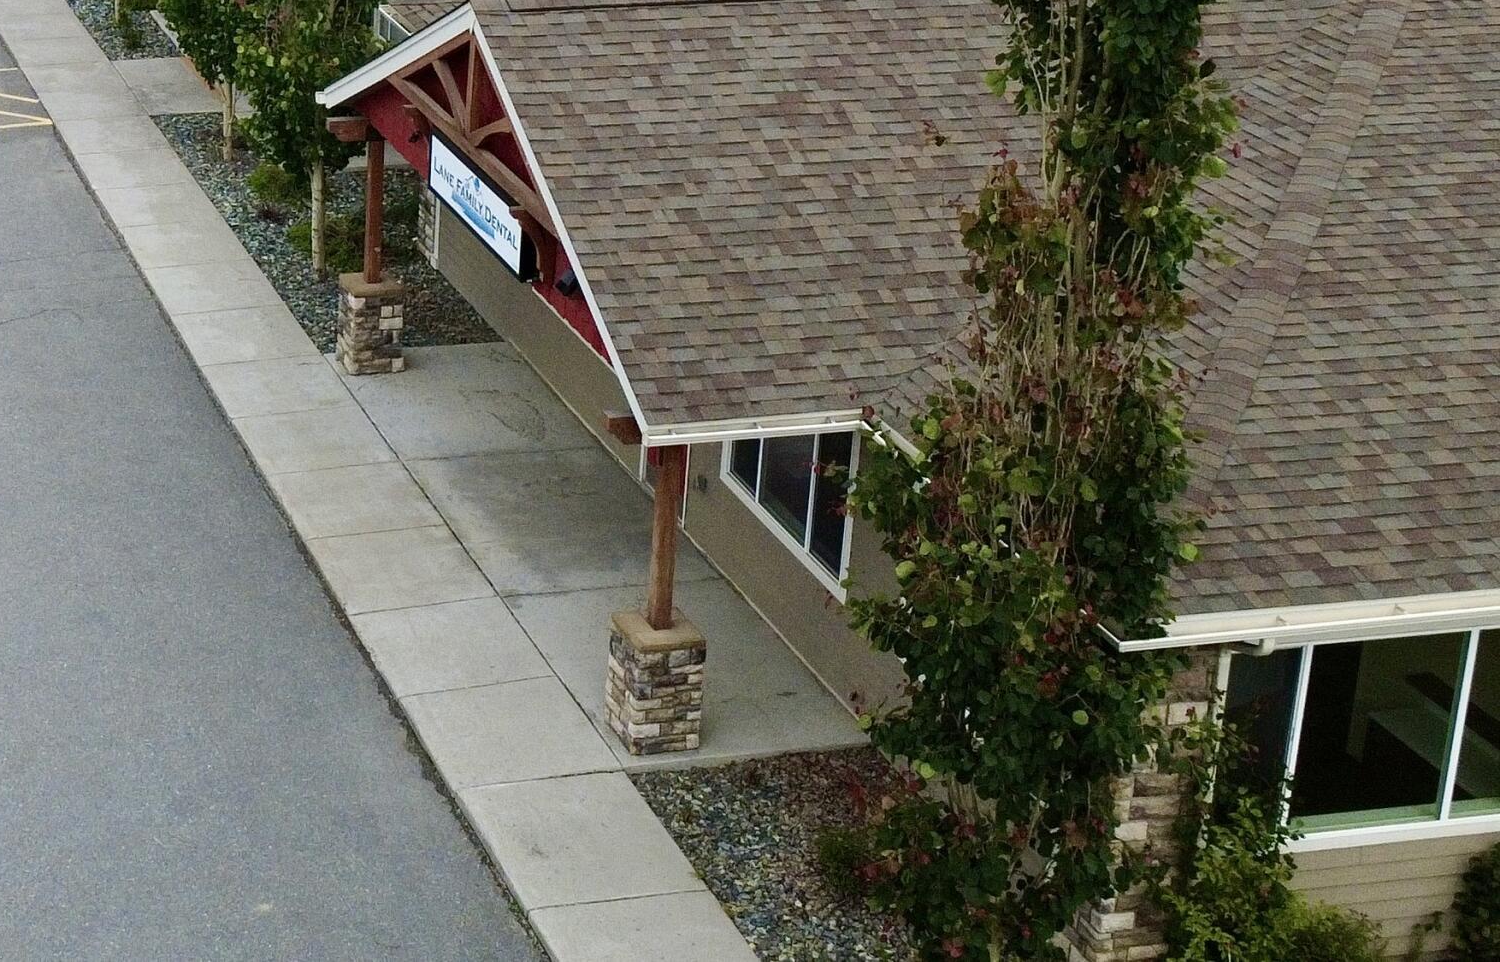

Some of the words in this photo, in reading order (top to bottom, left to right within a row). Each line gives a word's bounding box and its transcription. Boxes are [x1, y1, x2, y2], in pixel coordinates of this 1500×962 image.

[433, 156, 455, 188] LANE
[456, 179, 485, 216] FAMILY
[484, 205, 518, 251] DENTAL
